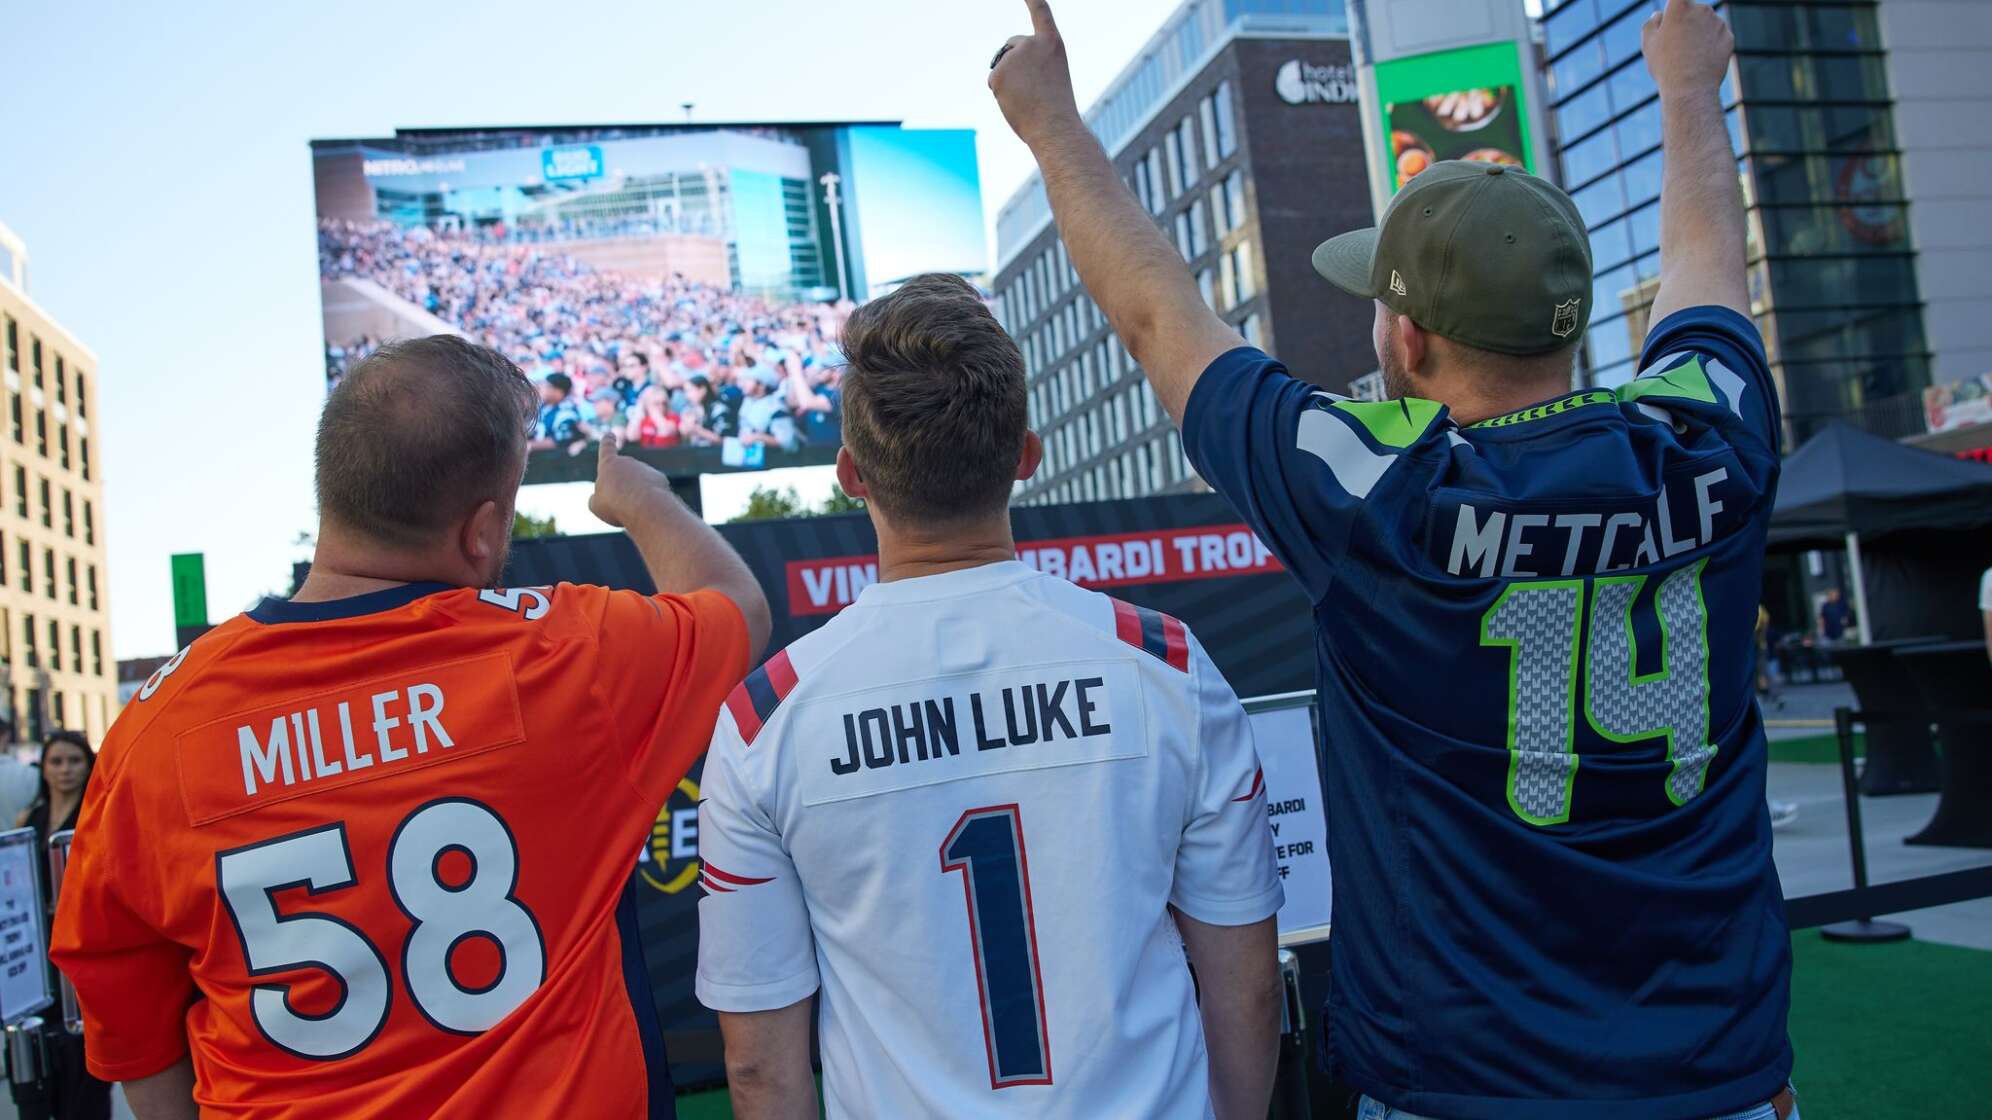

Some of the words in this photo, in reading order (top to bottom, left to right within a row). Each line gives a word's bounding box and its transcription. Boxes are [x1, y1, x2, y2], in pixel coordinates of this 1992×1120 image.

[1305, 81, 1358, 102] INDI
[801, 563, 878, 607] VIN
[1015, 538, 1164, 583] BARDI
[1173, 531, 1273, 573] TROP
[1447, 467, 1728, 578] METCALF
[237, 682, 455, 796] MILLER
[831, 697, 959, 776] JOHN
[970, 677, 1112, 752] LUKE
[1479, 557, 1718, 825] 14
[1267, 798, 1306, 816] BARDI
[1288, 840, 1314, 857] FOR
[215, 796, 547, 1062] 58
[939, 803, 1053, 1090] 1
